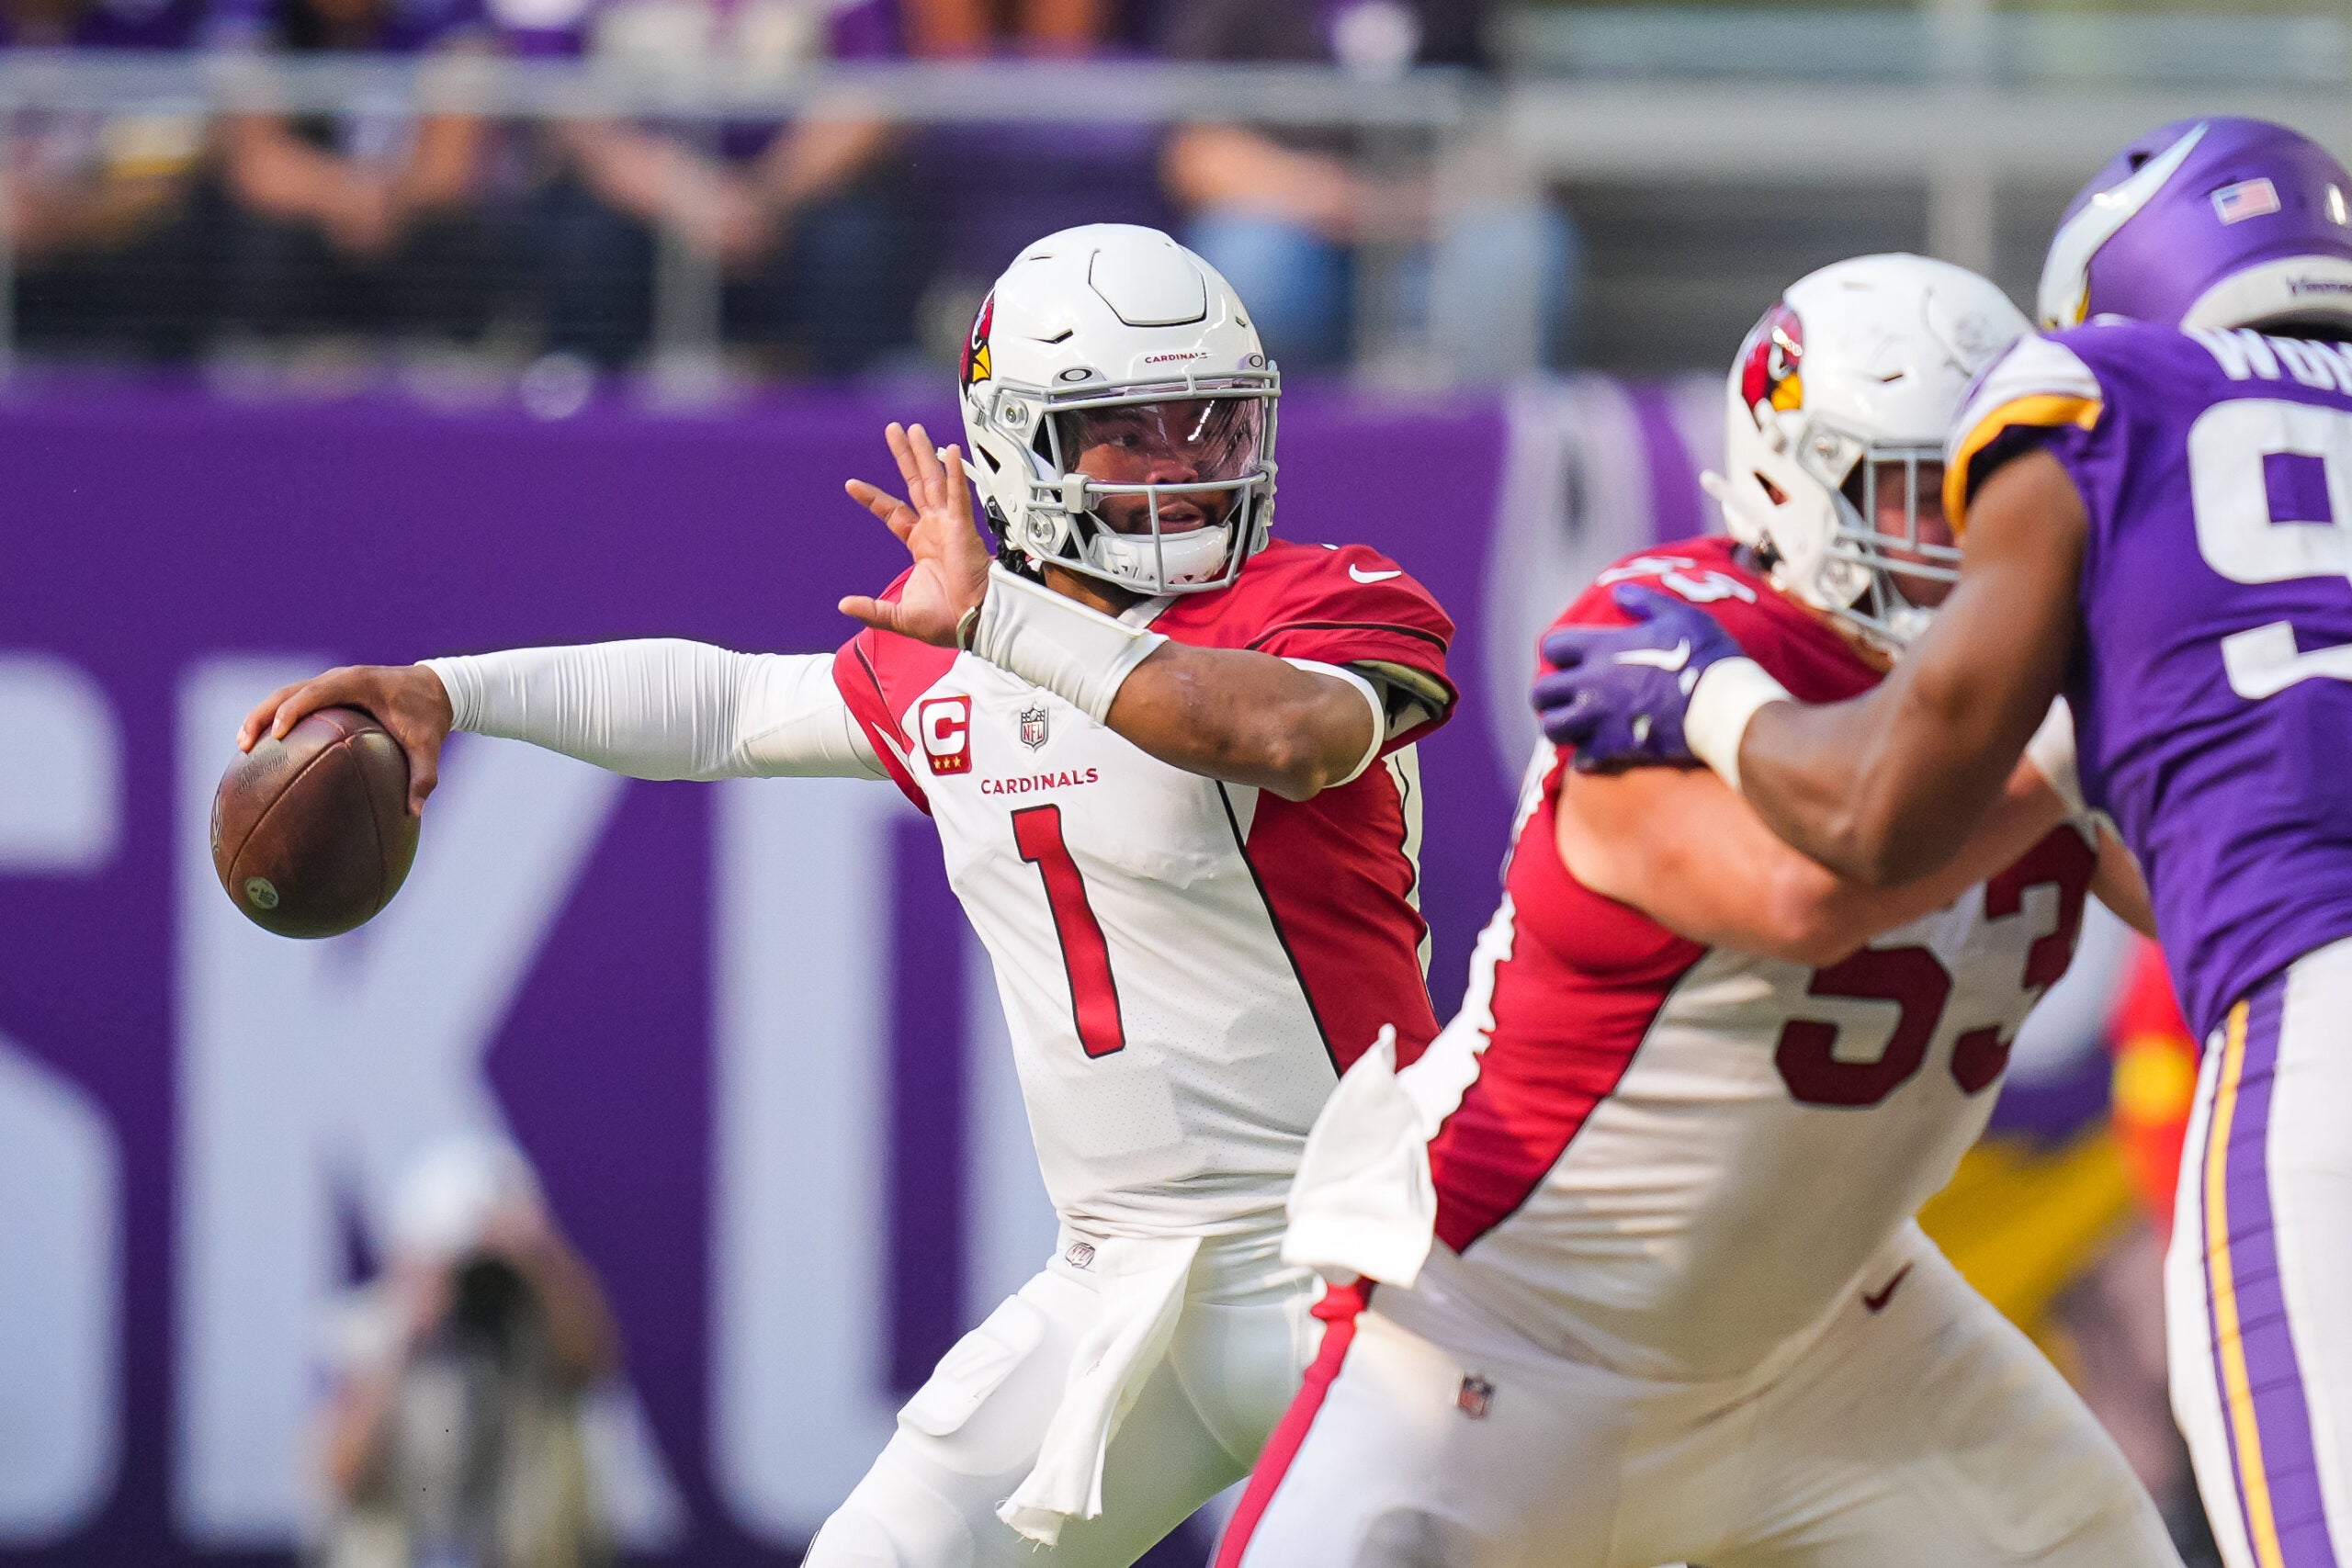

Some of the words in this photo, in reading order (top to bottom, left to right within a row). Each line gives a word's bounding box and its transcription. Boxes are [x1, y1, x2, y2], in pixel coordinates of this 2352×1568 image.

[2187, 397, 2352, 700] 9
[921, 699, 966, 757] C
[980, 767, 1099, 795] CARDINALS
[1023, 723, 1044, 743] NFL
[1011, 803, 1125, 1060] 1
[1774, 822, 2098, 1109] 53
